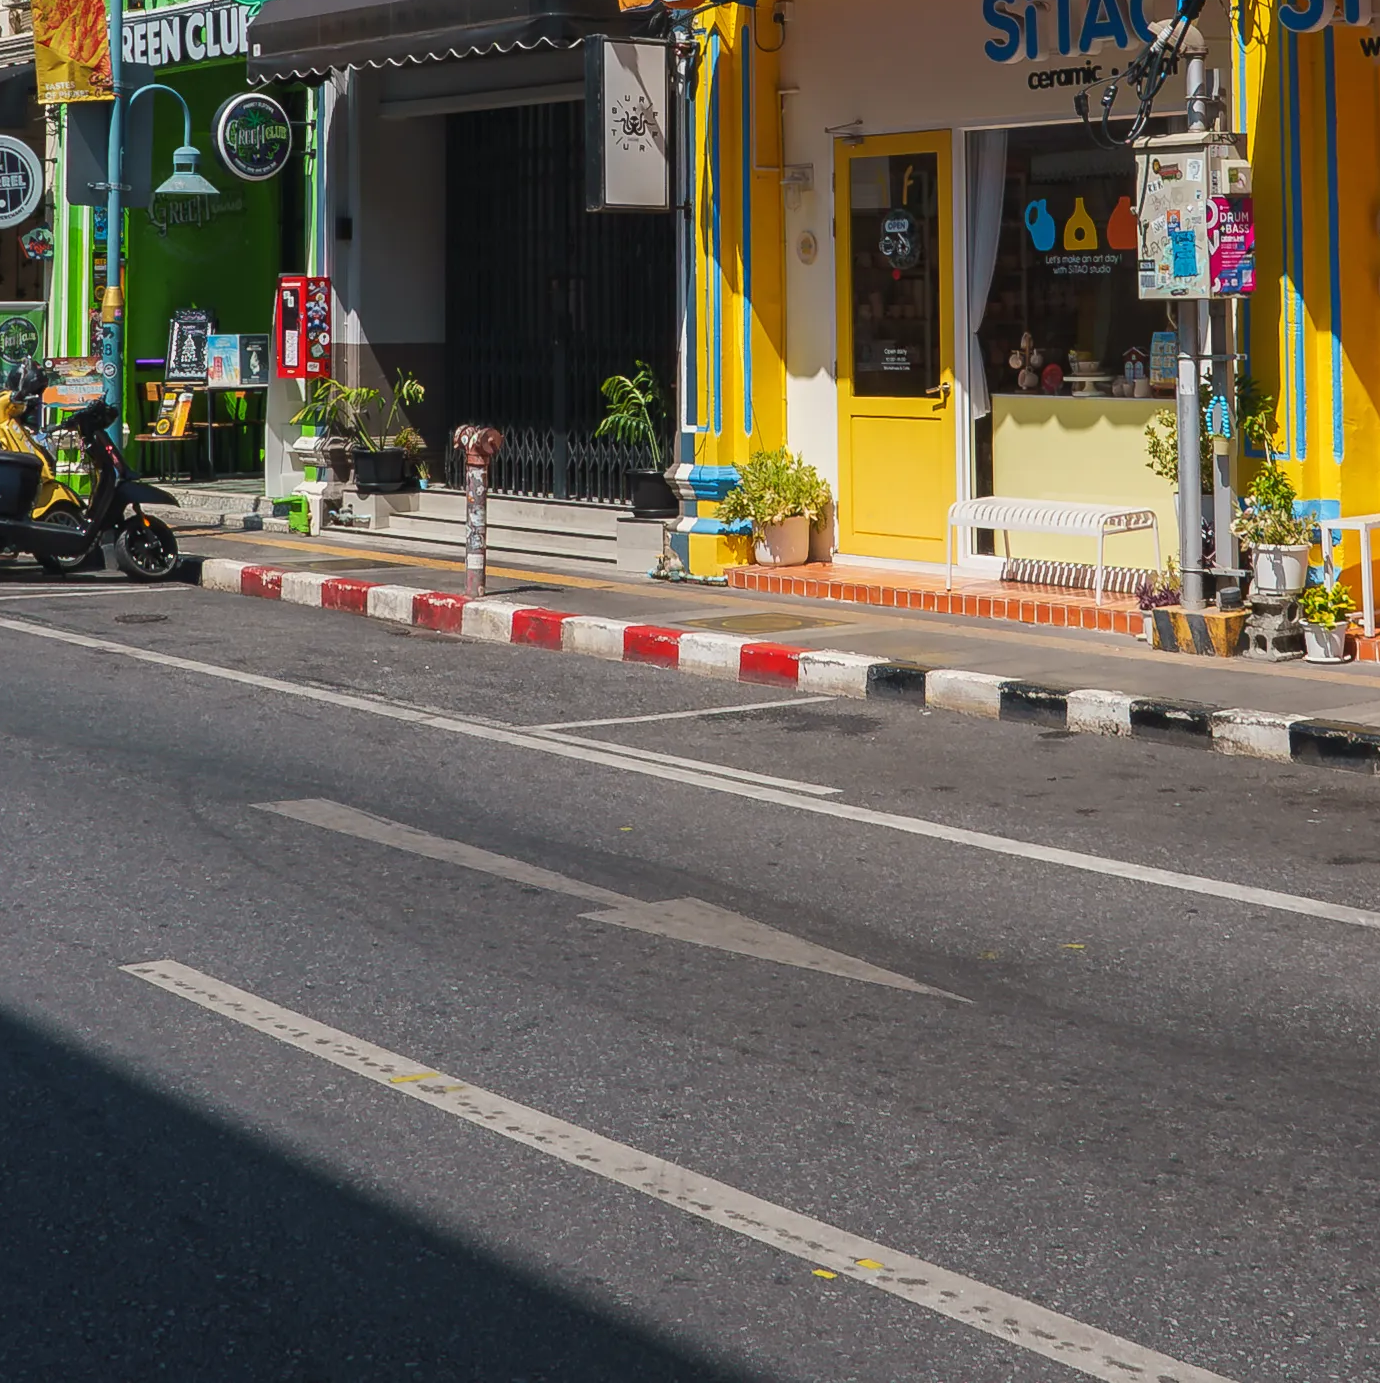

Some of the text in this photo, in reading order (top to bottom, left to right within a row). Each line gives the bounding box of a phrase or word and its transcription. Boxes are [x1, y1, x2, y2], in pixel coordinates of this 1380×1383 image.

[107, 16, 181, 67] REEN
[1027, 59, 1103, 90] ceramic
[44, 80, 76, 91] TASTES
[44, 91, 57, 100] OF
[265, 125, 287, 140] CLUB
[1219, 211, 1249, 223] DRUM
[887, 221, 906, 230] OPEN
[1045, 255, 1061, 264] Let's
[1061, 255, 1081, 264] make
[1092, 254, 1104, 263] art
[1052, 266, 1068, 275] with
[1089, 264, 1112, 274] studio
